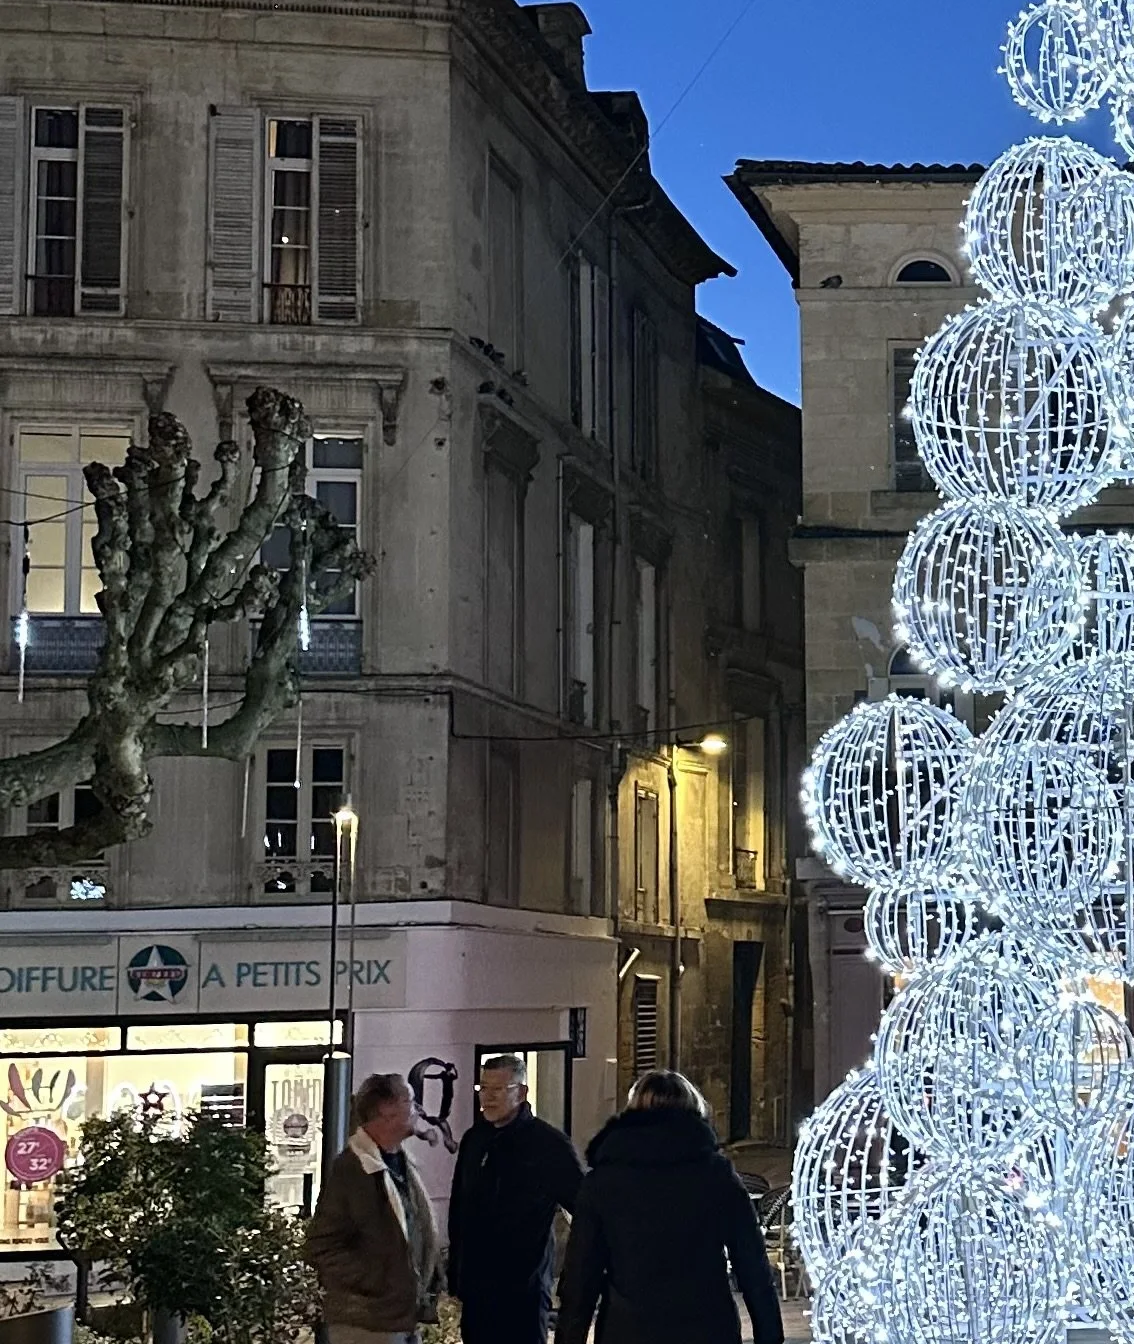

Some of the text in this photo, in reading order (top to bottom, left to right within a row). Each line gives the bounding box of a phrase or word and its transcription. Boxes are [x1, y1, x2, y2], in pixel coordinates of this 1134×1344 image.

[202, 963, 225, 988] A
[236, 961, 321, 987] PETITS
[335, 960, 392, 985] PRIX
